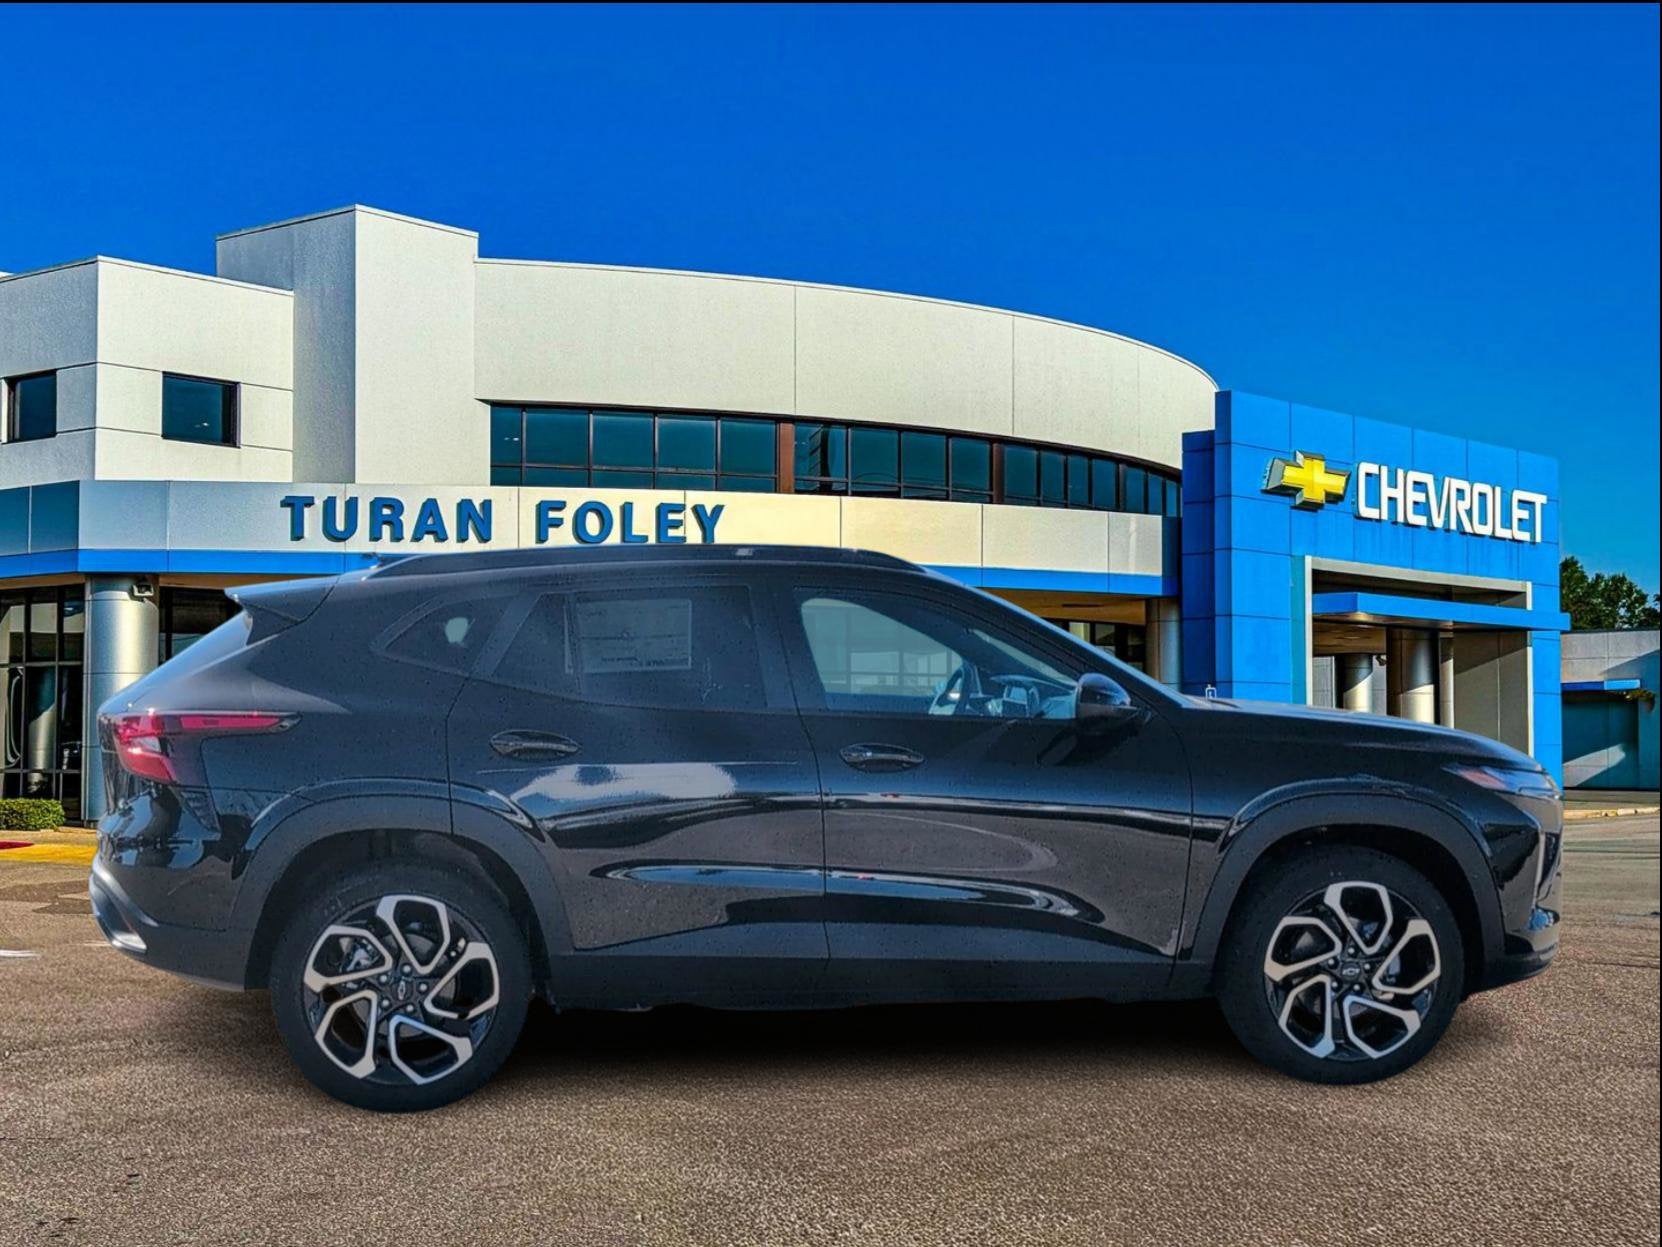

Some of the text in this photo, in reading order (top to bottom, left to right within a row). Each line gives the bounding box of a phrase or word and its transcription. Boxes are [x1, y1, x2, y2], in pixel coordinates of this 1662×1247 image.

[280, 495, 725, 544] TURAN FOLEY
[1357, 462, 1547, 543] CHEVROLET
